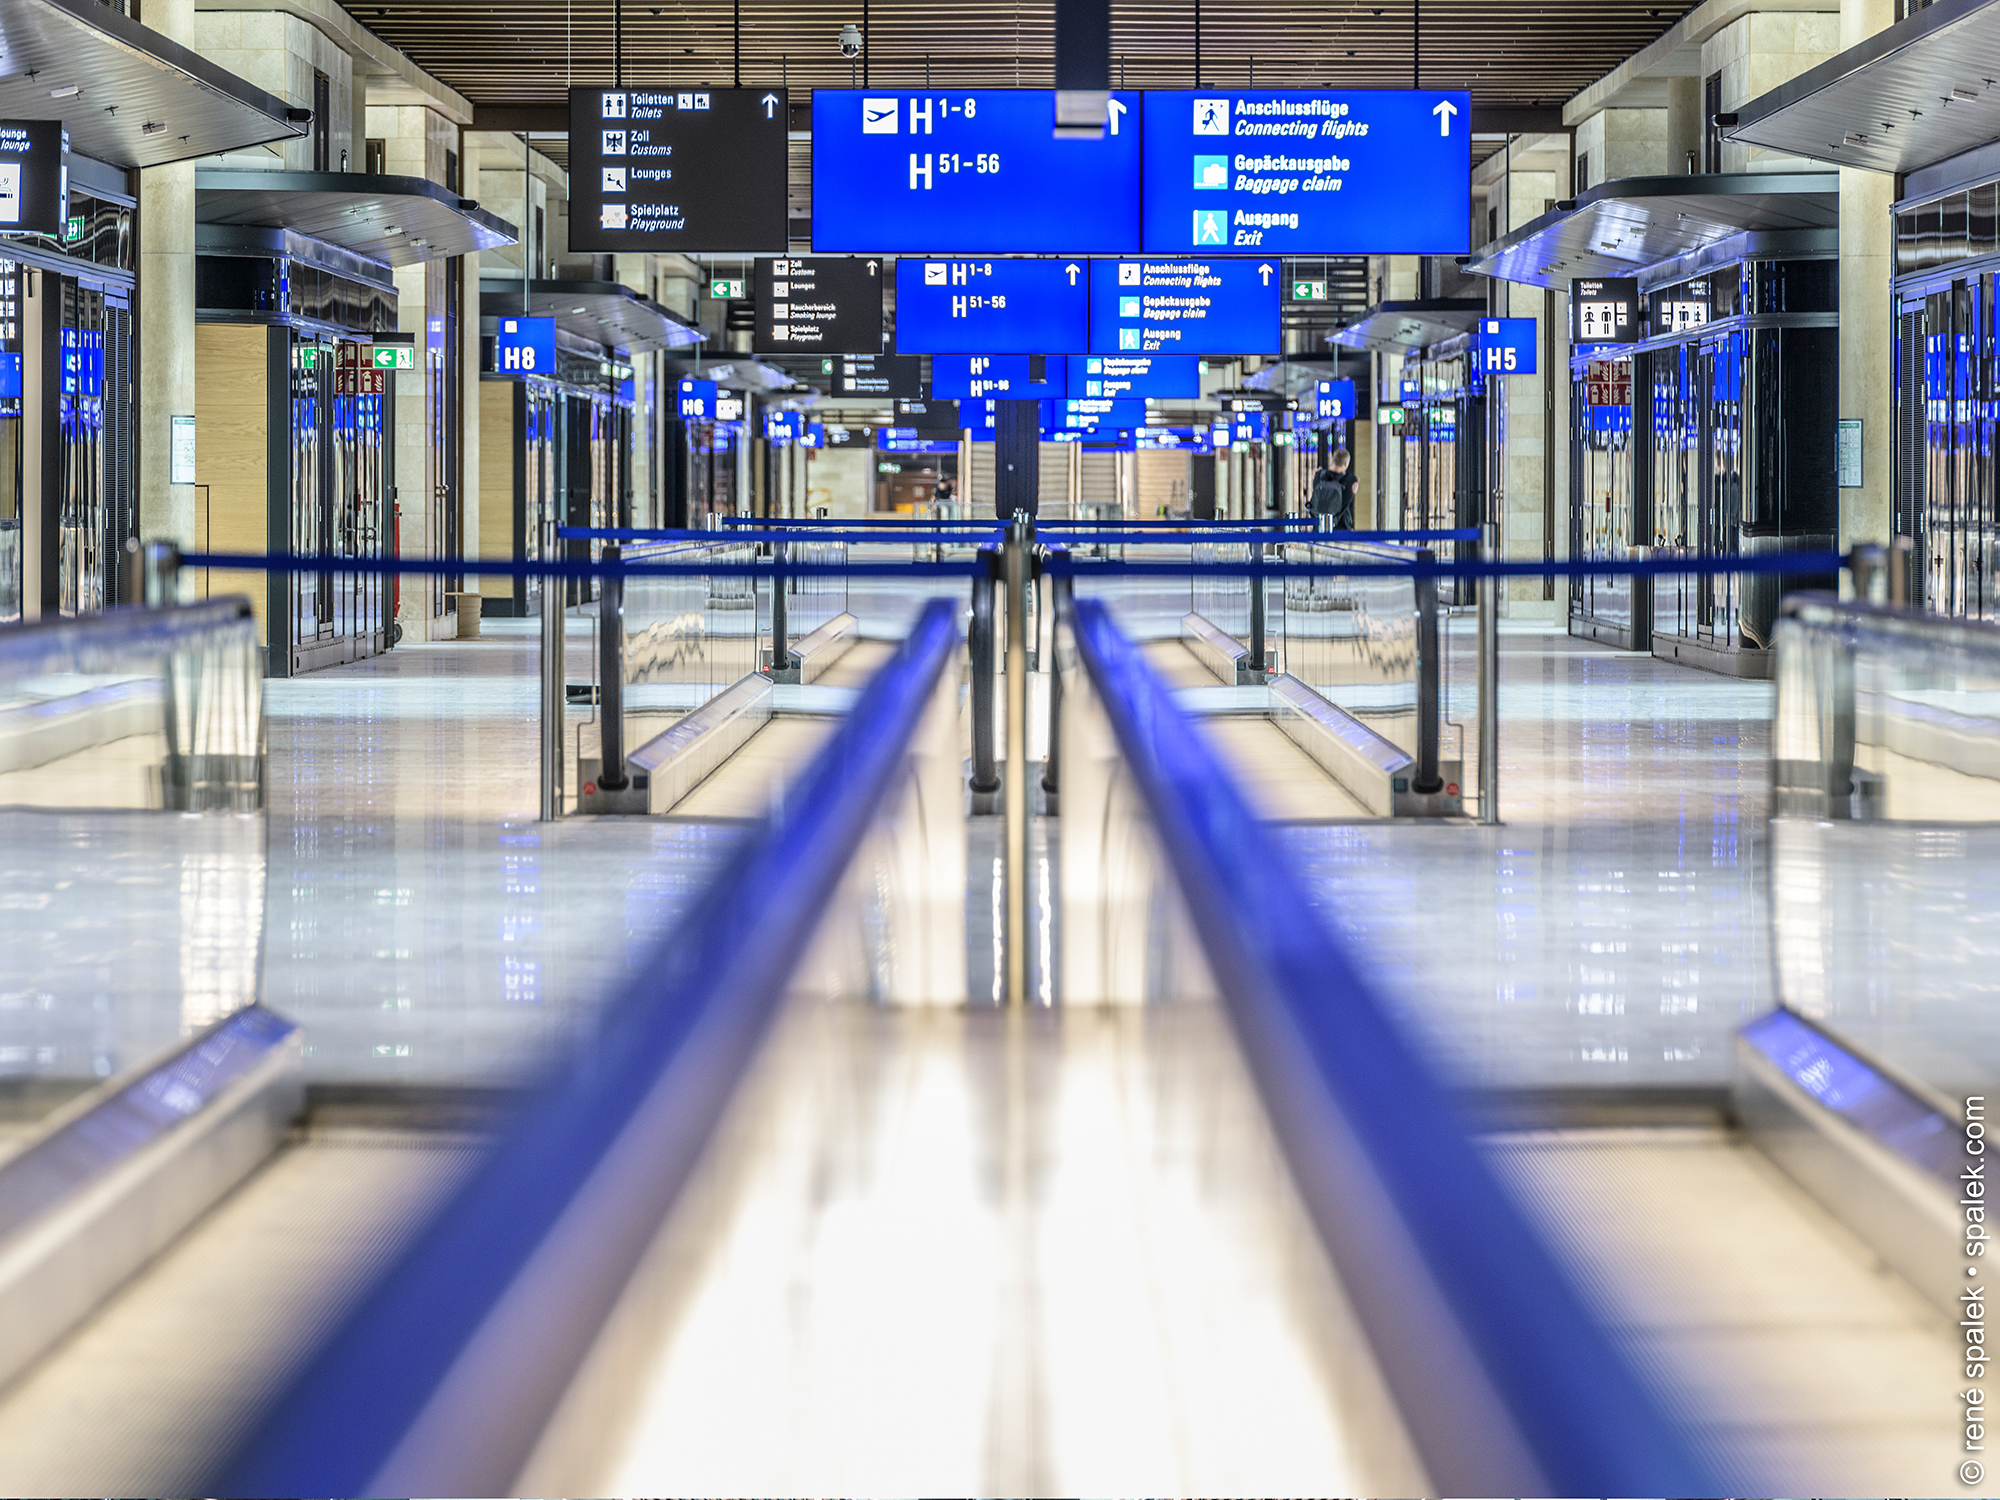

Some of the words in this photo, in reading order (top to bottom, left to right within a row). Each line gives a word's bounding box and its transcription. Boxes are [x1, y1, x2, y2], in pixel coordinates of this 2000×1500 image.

[630, 92, 674, 106] Toiletten
[631, 106, 663, 119] Toilets
[909, 98, 932, 135] H
[1234, 99, 1349, 119] Anschlussflüge
[0, 127, 28, 140] ounge
[630, 129, 650, 142] Zoll
[1234, 119, 1318, 139] Connecting
[1321, 120, 1369, 139] flights
[1, 139, 31, 152] lounge
[630, 143, 673, 156] Customs
[909, 153, 932, 190] H
[1234, 154, 1350, 174] Gepäckausgabe
[631, 166, 672, 182] Lounges
[1234, 174, 1299, 195] Baggage
[1302, 175, 1342, 191] claim
[630, 203, 679, 219] Spielplatz
[1233, 209, 1299, 229] Ausgang
[630, 217, 685, 233] Playground
[1233, 229, 1264, 246] Exit
[789, 260, 802, 268] Zoll
[1143, 263, 1210, 275] Anschlussflüge
[952, 263, 967, 286] H
[1143, 275, 1192, 288] Connecting
[1193, 275, 1222, 288] flights
[952, 295, 967, 318] H
[1143, 295, 1211, 308] Gepäckausgabe
[1143, 307, 1181, 320] Baggage
[1182, 308, 1206, 318] claim
[1143, 327, 1181, 341] Ausgang
[1143, 340, 1160, 350] Exit
[504, 346, 535, 370] H8
[970, 357, 983, 375] H
[1486, 347, 1517, 370] H5
[970, 379, 983, 397] H
[682, 399, 704, 416] H6
[1319, 399, 1341, 417] H3
